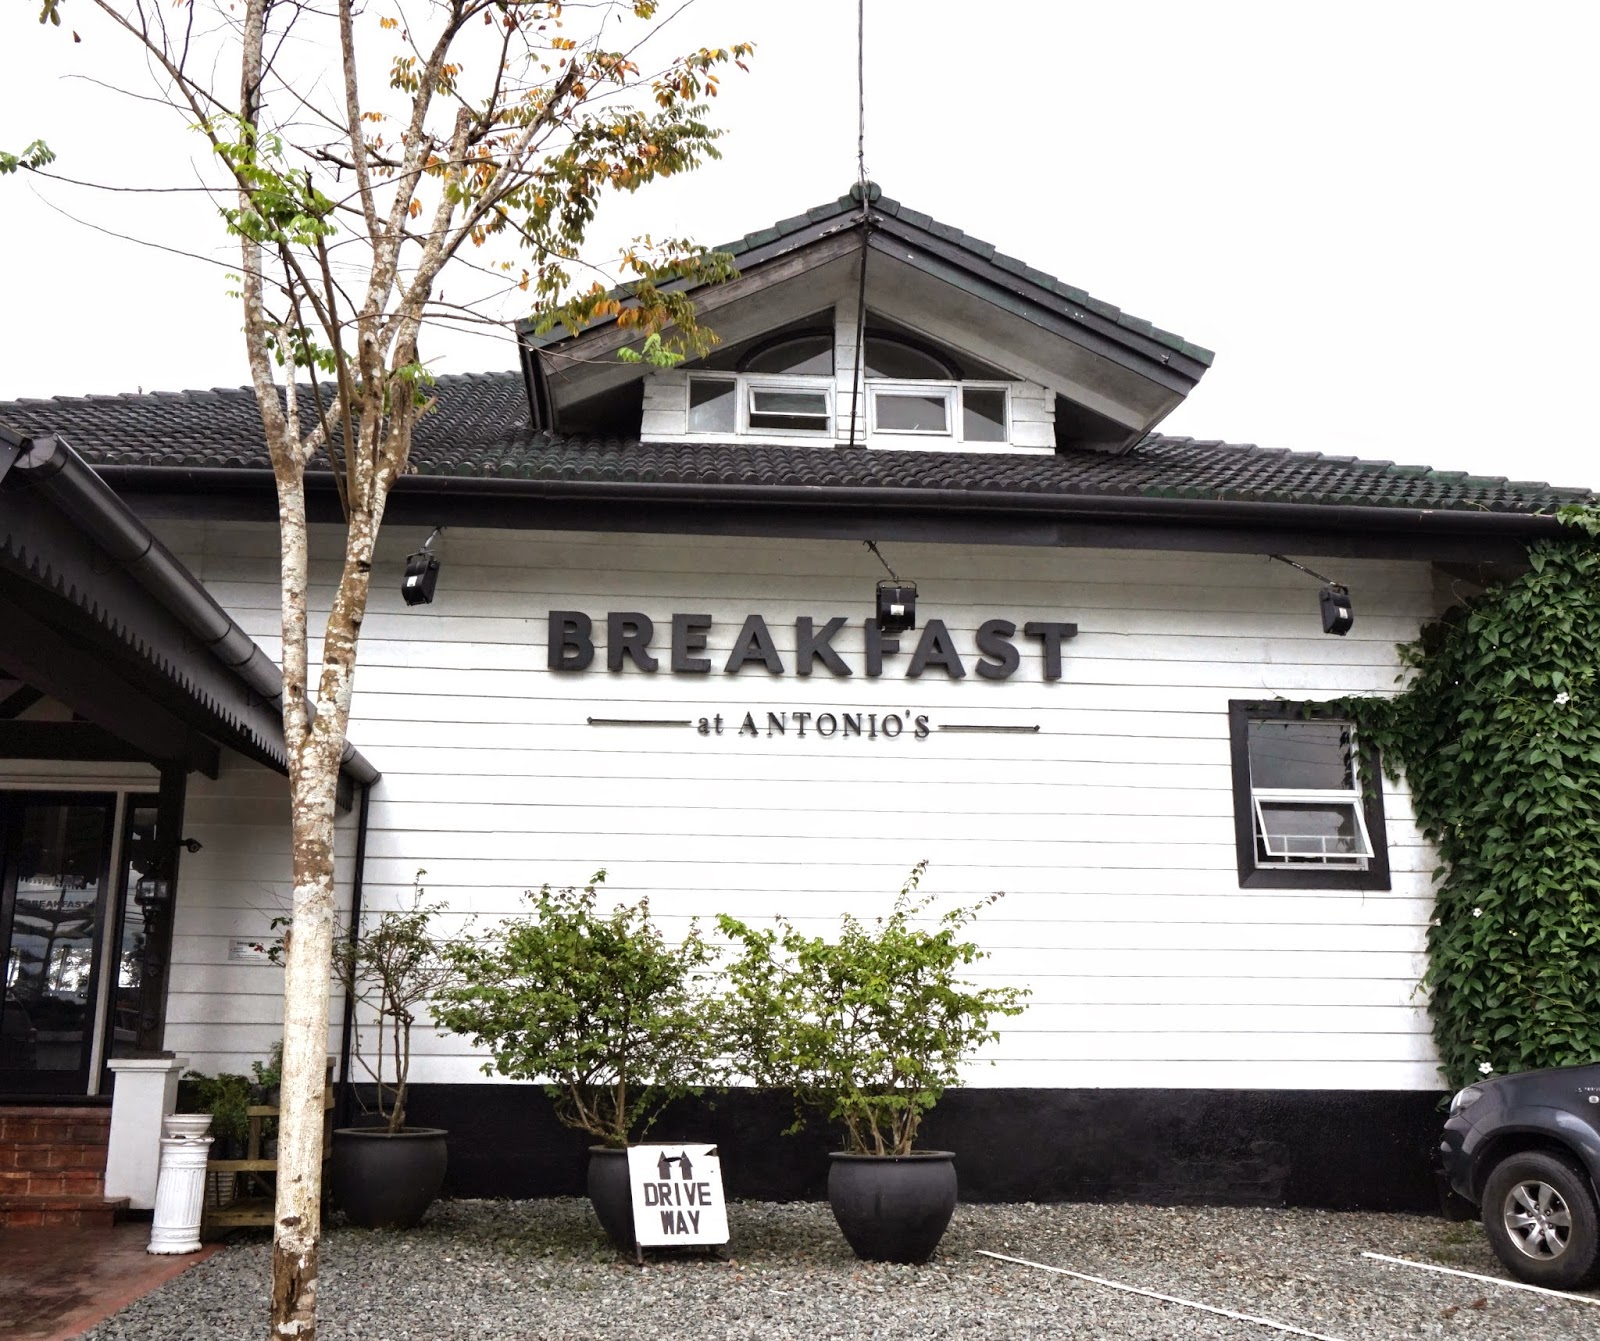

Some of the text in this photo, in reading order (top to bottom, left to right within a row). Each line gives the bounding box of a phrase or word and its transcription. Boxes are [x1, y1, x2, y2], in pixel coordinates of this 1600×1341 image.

[547, 610, 1078, 681] BREAKFAST
[697, 709, 930, 740] at ANTONIO'S
[643, 1182, 712, 1207] DRIVE
[660, 1210, 700, 1235] WAY
